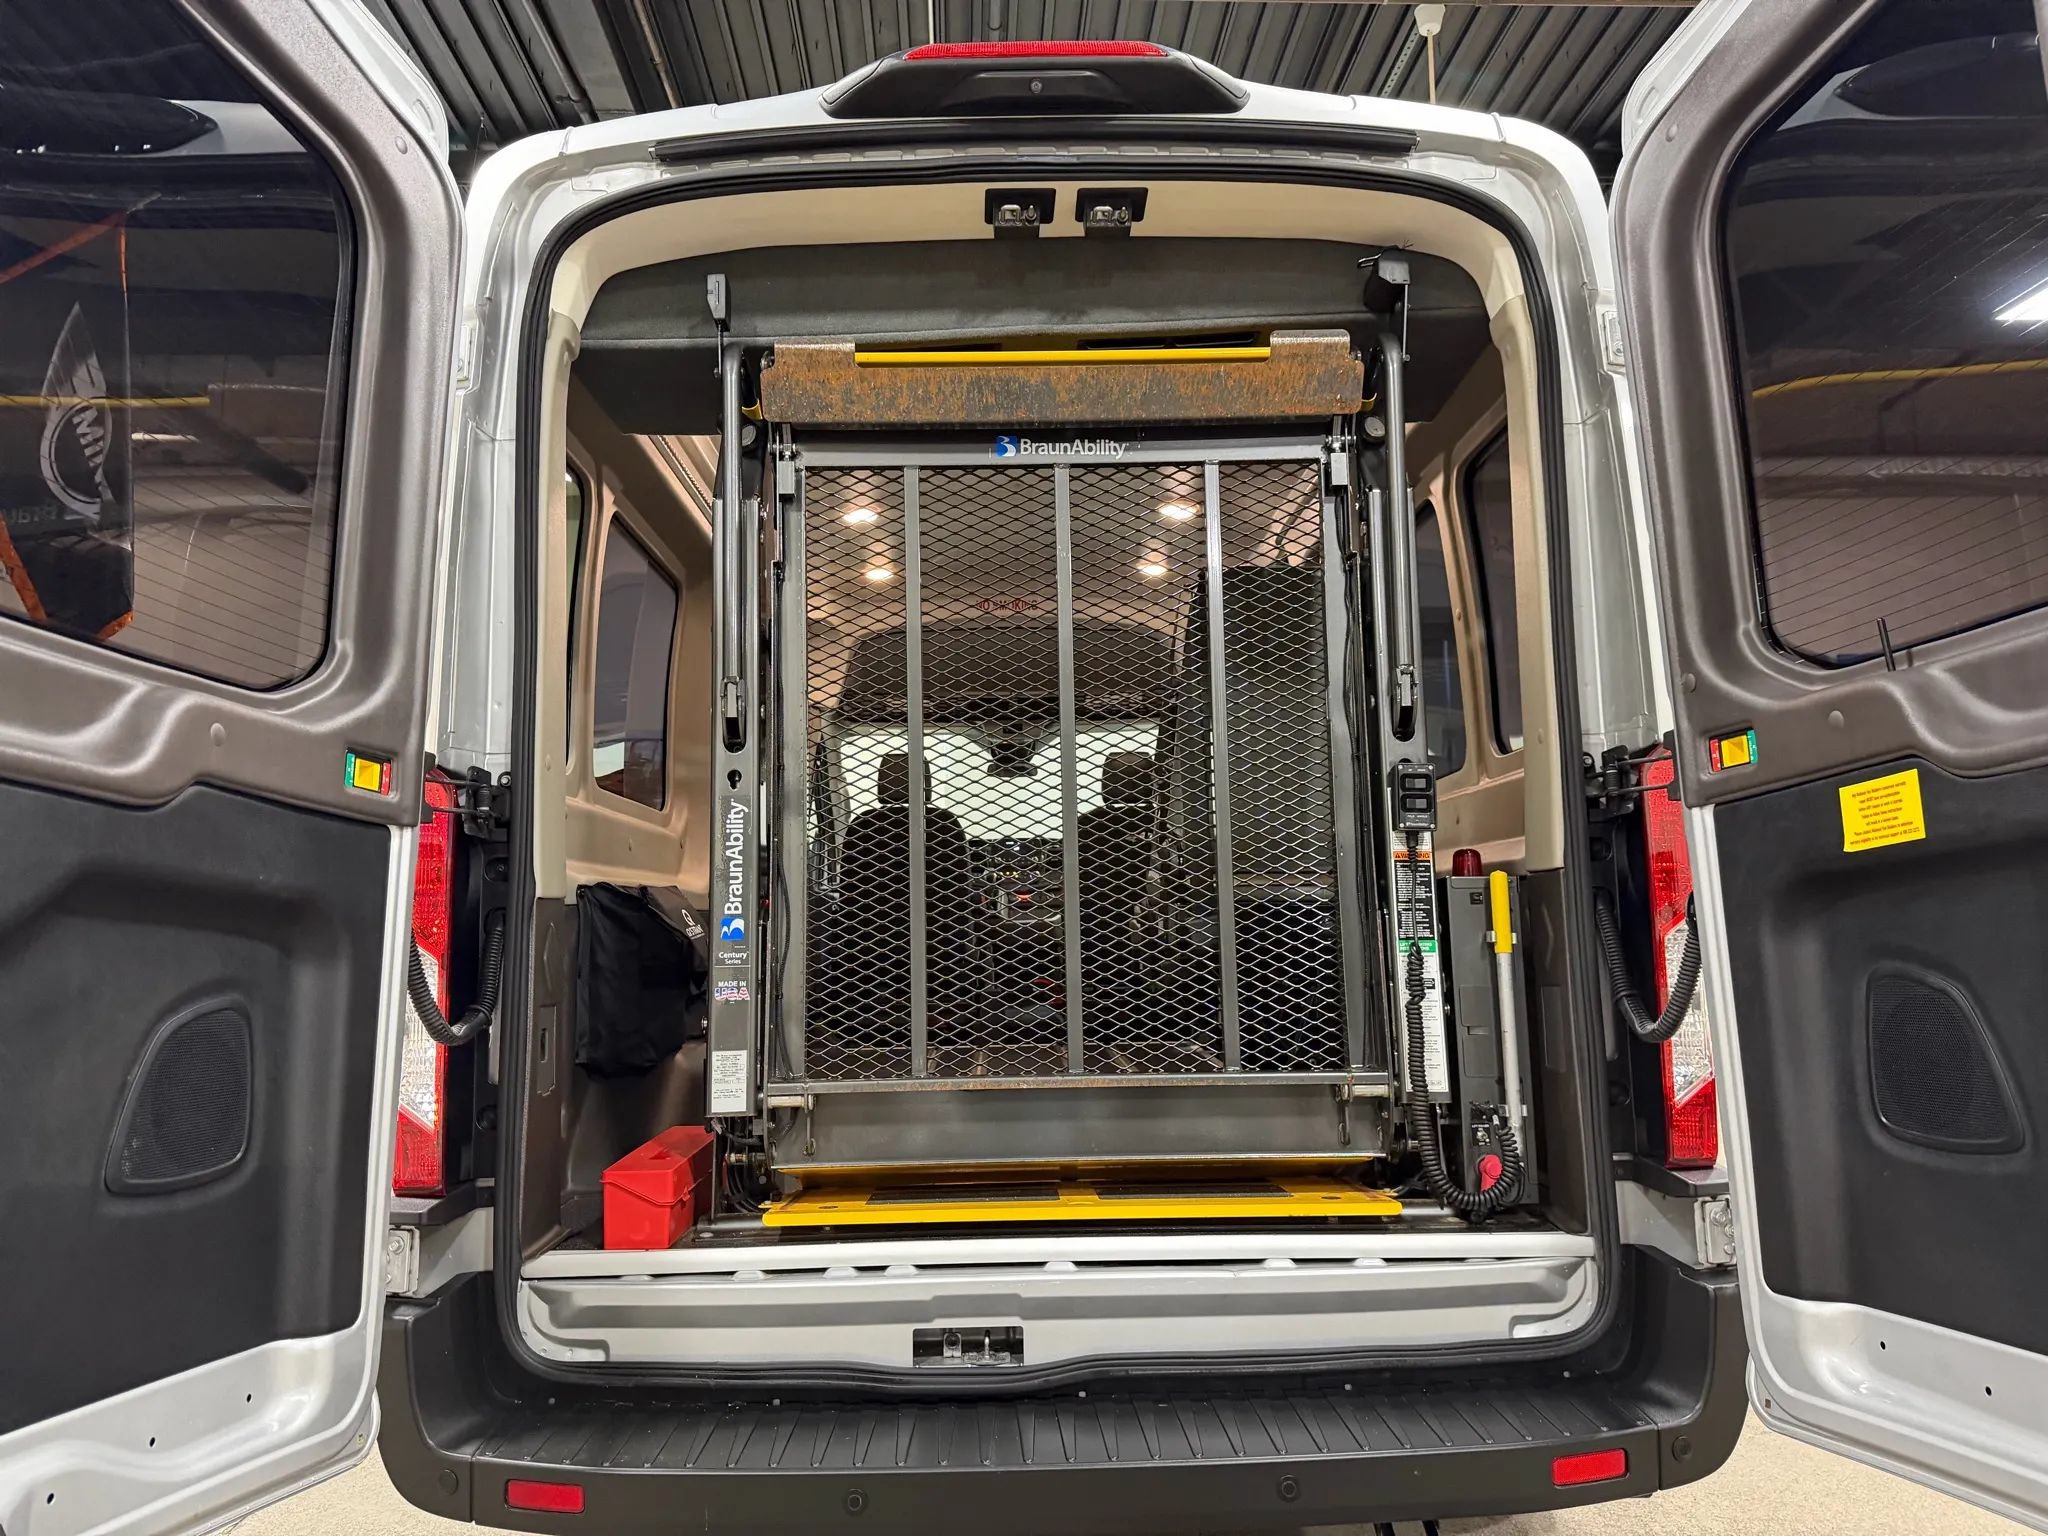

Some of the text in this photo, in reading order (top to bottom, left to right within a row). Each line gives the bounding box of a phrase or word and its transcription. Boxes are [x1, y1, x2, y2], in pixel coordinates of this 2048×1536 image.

[1020, 438, 1126, 460] BraunAbility
[724, 799, 749, 915] BraunAbility
[718, 951, 748, 960] Century
[714, 987, 751, 1001] USA
